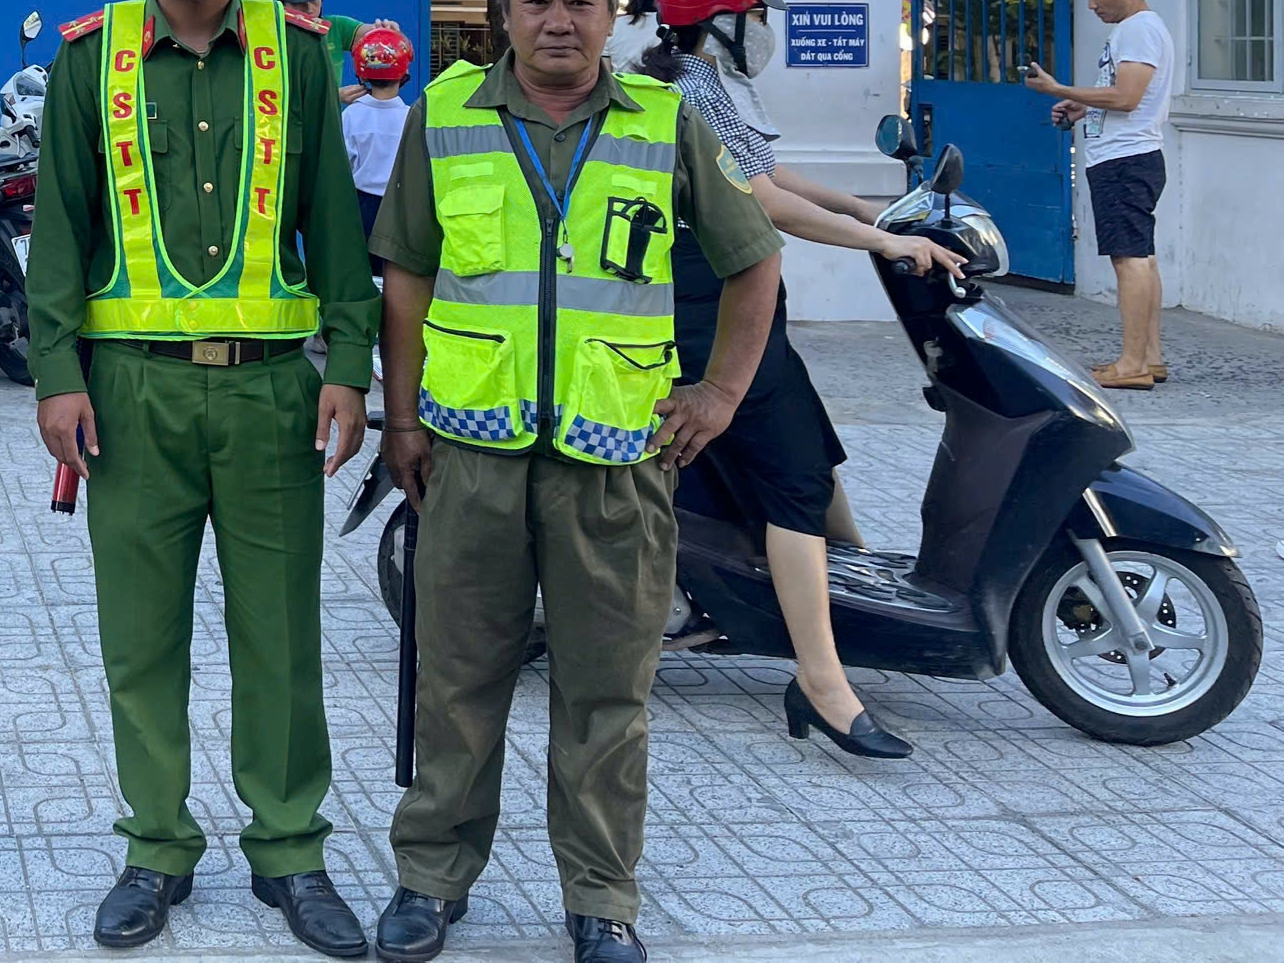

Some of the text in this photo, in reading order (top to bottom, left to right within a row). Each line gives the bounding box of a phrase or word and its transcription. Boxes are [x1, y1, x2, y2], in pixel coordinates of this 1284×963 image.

[792, 11, 864, 26] XIN VUI LÒNG
[790, 36, 816, 47] XUỐNG
[817, 39, 827, 47] XE
[848, 37, 865, 47] MÁY
[817, 52, 832, 61] QUA
